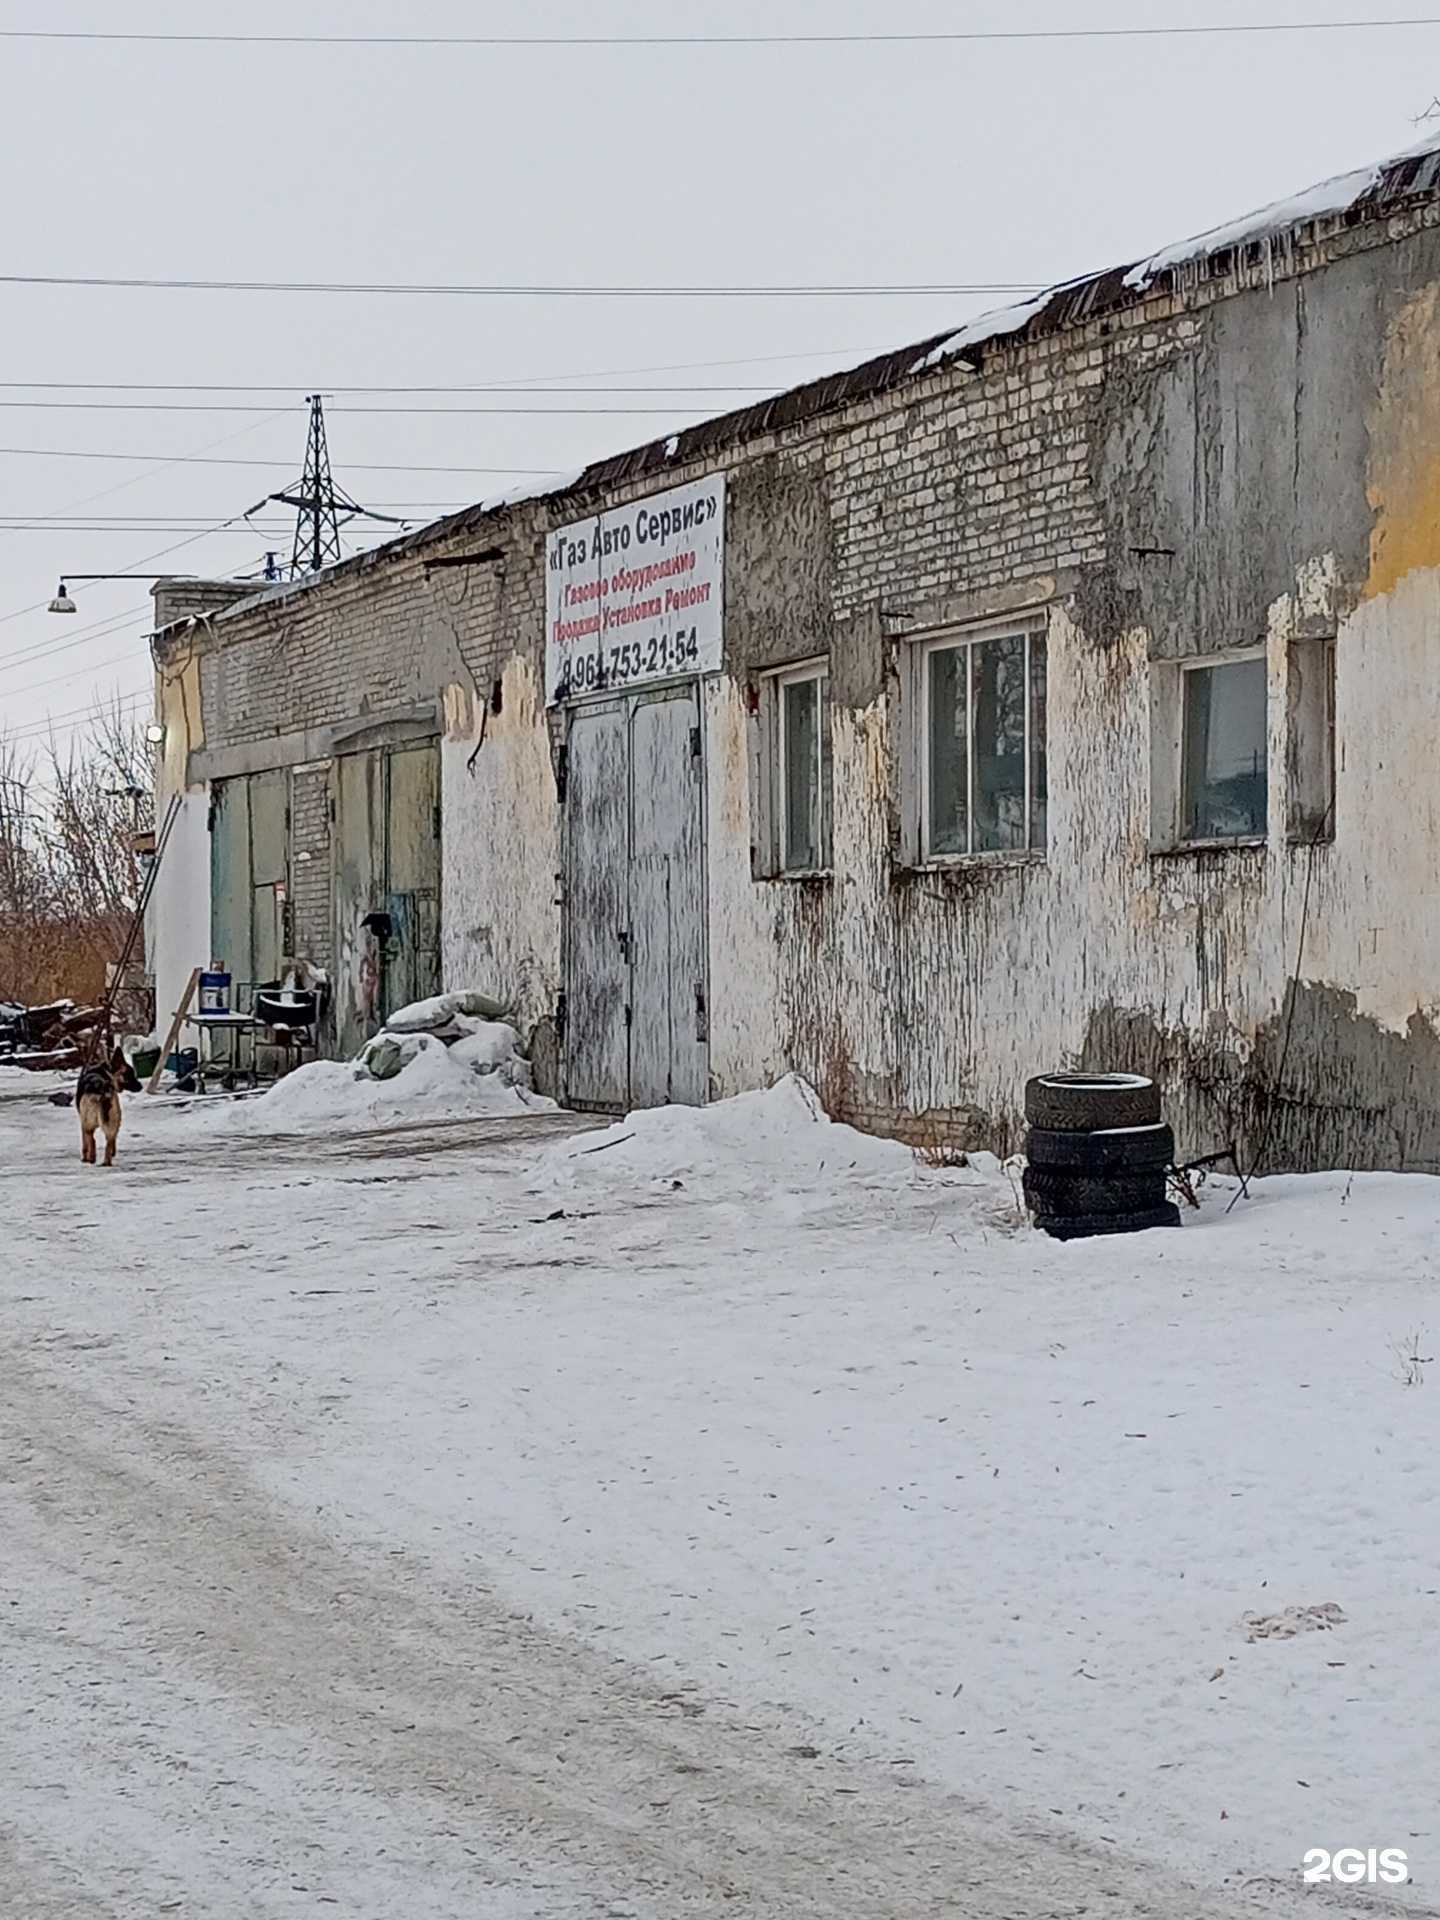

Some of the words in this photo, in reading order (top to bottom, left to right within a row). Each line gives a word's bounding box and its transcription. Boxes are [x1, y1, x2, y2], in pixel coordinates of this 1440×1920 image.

[549, 536, 586, 571] «Газ
[592, 525, 630, 558] Авто
[636, 496, 717, 546] Сервис»
[564, 577, 608, 608] Газовое
[612, 550, 696, 592] оборудование
[602, 595, 662, 630] Установка
[665, 582, 712, 612] Ремонт
